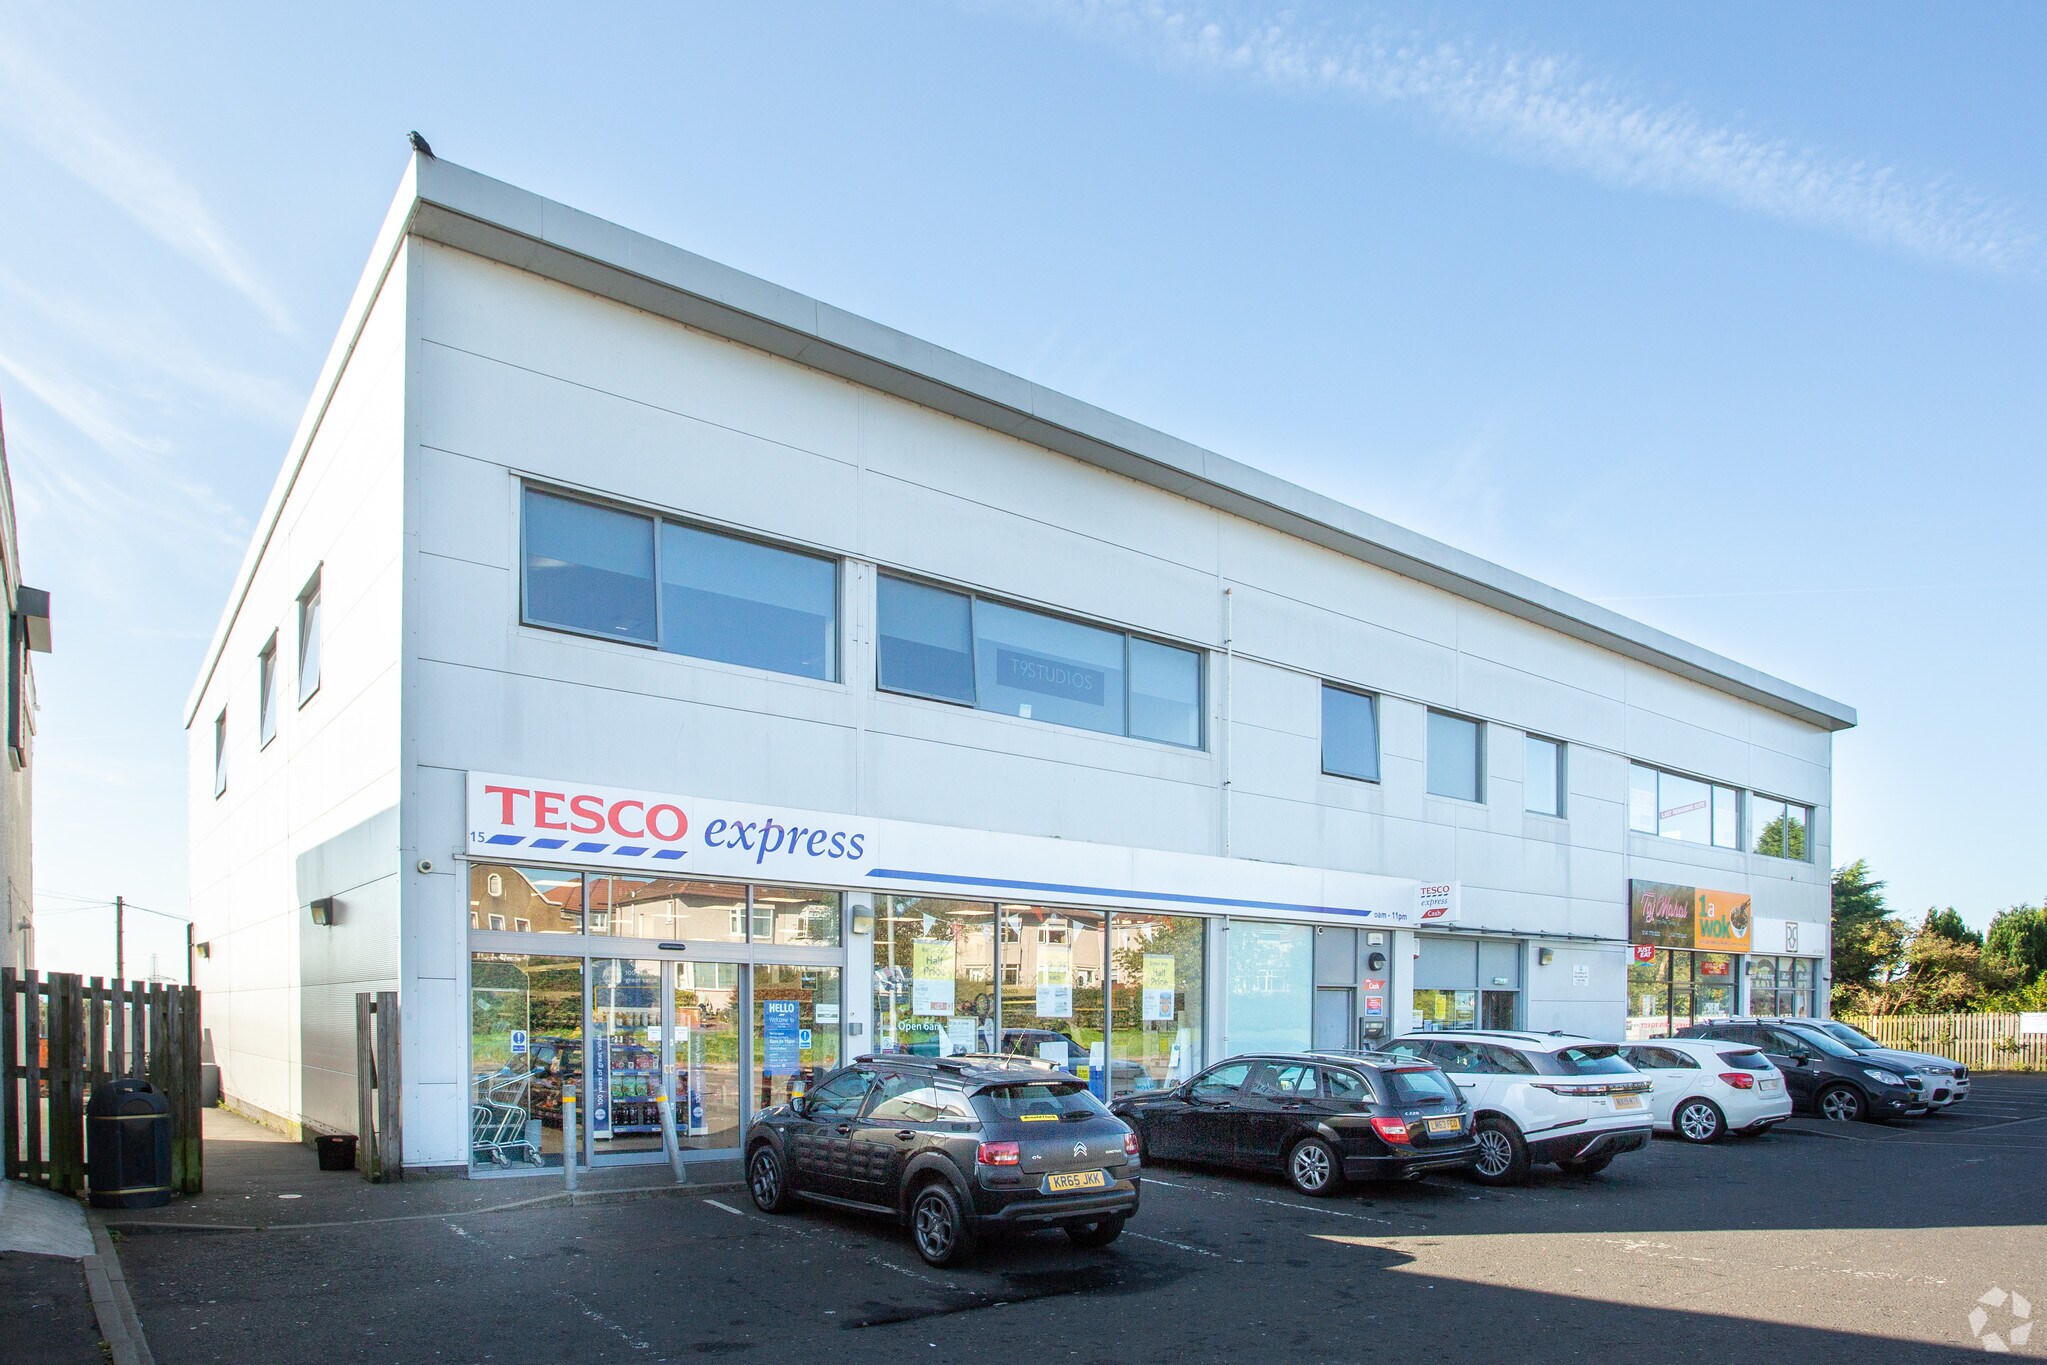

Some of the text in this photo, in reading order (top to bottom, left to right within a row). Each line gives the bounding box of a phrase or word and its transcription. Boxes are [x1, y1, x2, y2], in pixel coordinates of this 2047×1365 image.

[1010, 659, 1093, 690] T9STUDIOS
[485, 785, 865, 864] TESCO express
[470, 831, 485, 843] 15
[1420, 885, 1450, 895] TESCO
[1421, 897, 1448, 908] express
[1392, 911, 1408, 921] 11pm
[1699, 914, 1731, 939] wok
[1637, 946, 1652, 954] JUST
[926, 955, 944, 965] Half
[1152, 969, 1166, 977] Half
[1150, 978, 1168, 987] Price
[1368, 982, 1380, 990] Cash
[769, 1003, 794, 1013] HELLO
[898, 1021, 922, 1033] Open
[597, 1077, 605, 1093] years
[1053, 1173, 1101, 1188] KR65 JKK
